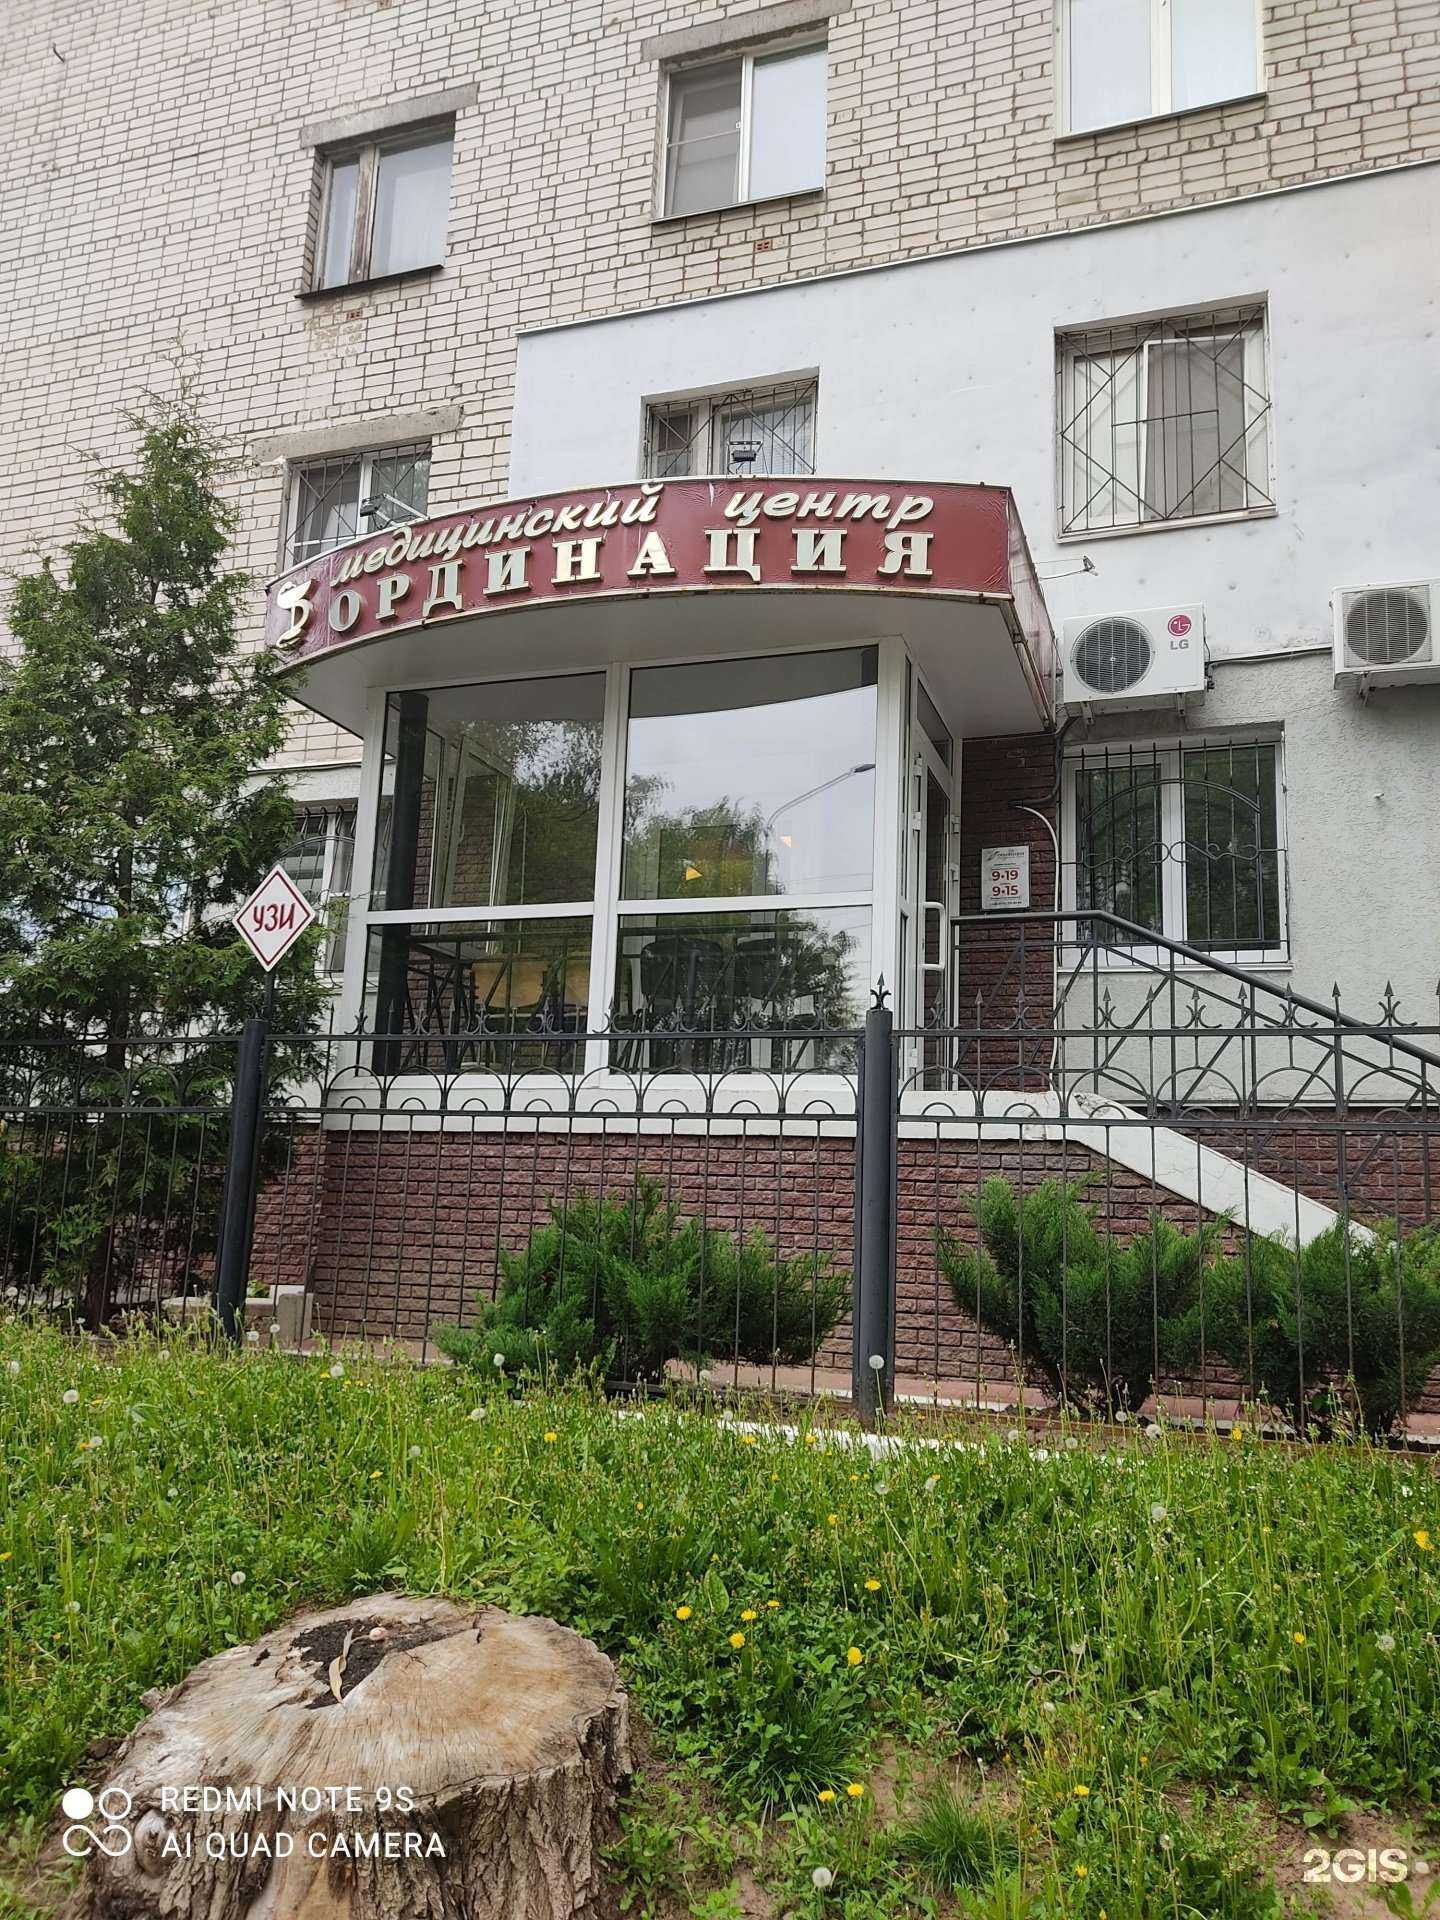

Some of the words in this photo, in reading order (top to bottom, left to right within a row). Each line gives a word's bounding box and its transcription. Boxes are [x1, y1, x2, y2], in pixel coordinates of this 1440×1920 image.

[330, 482, 664, 588] медицинский
[723, 490, 935, 531] центр
[328, 528, 935, 633] ОРДИНАЦИЯ
[1170, 639, 1189, 650] LG
[253, 903, 296, 932] УЗИ
